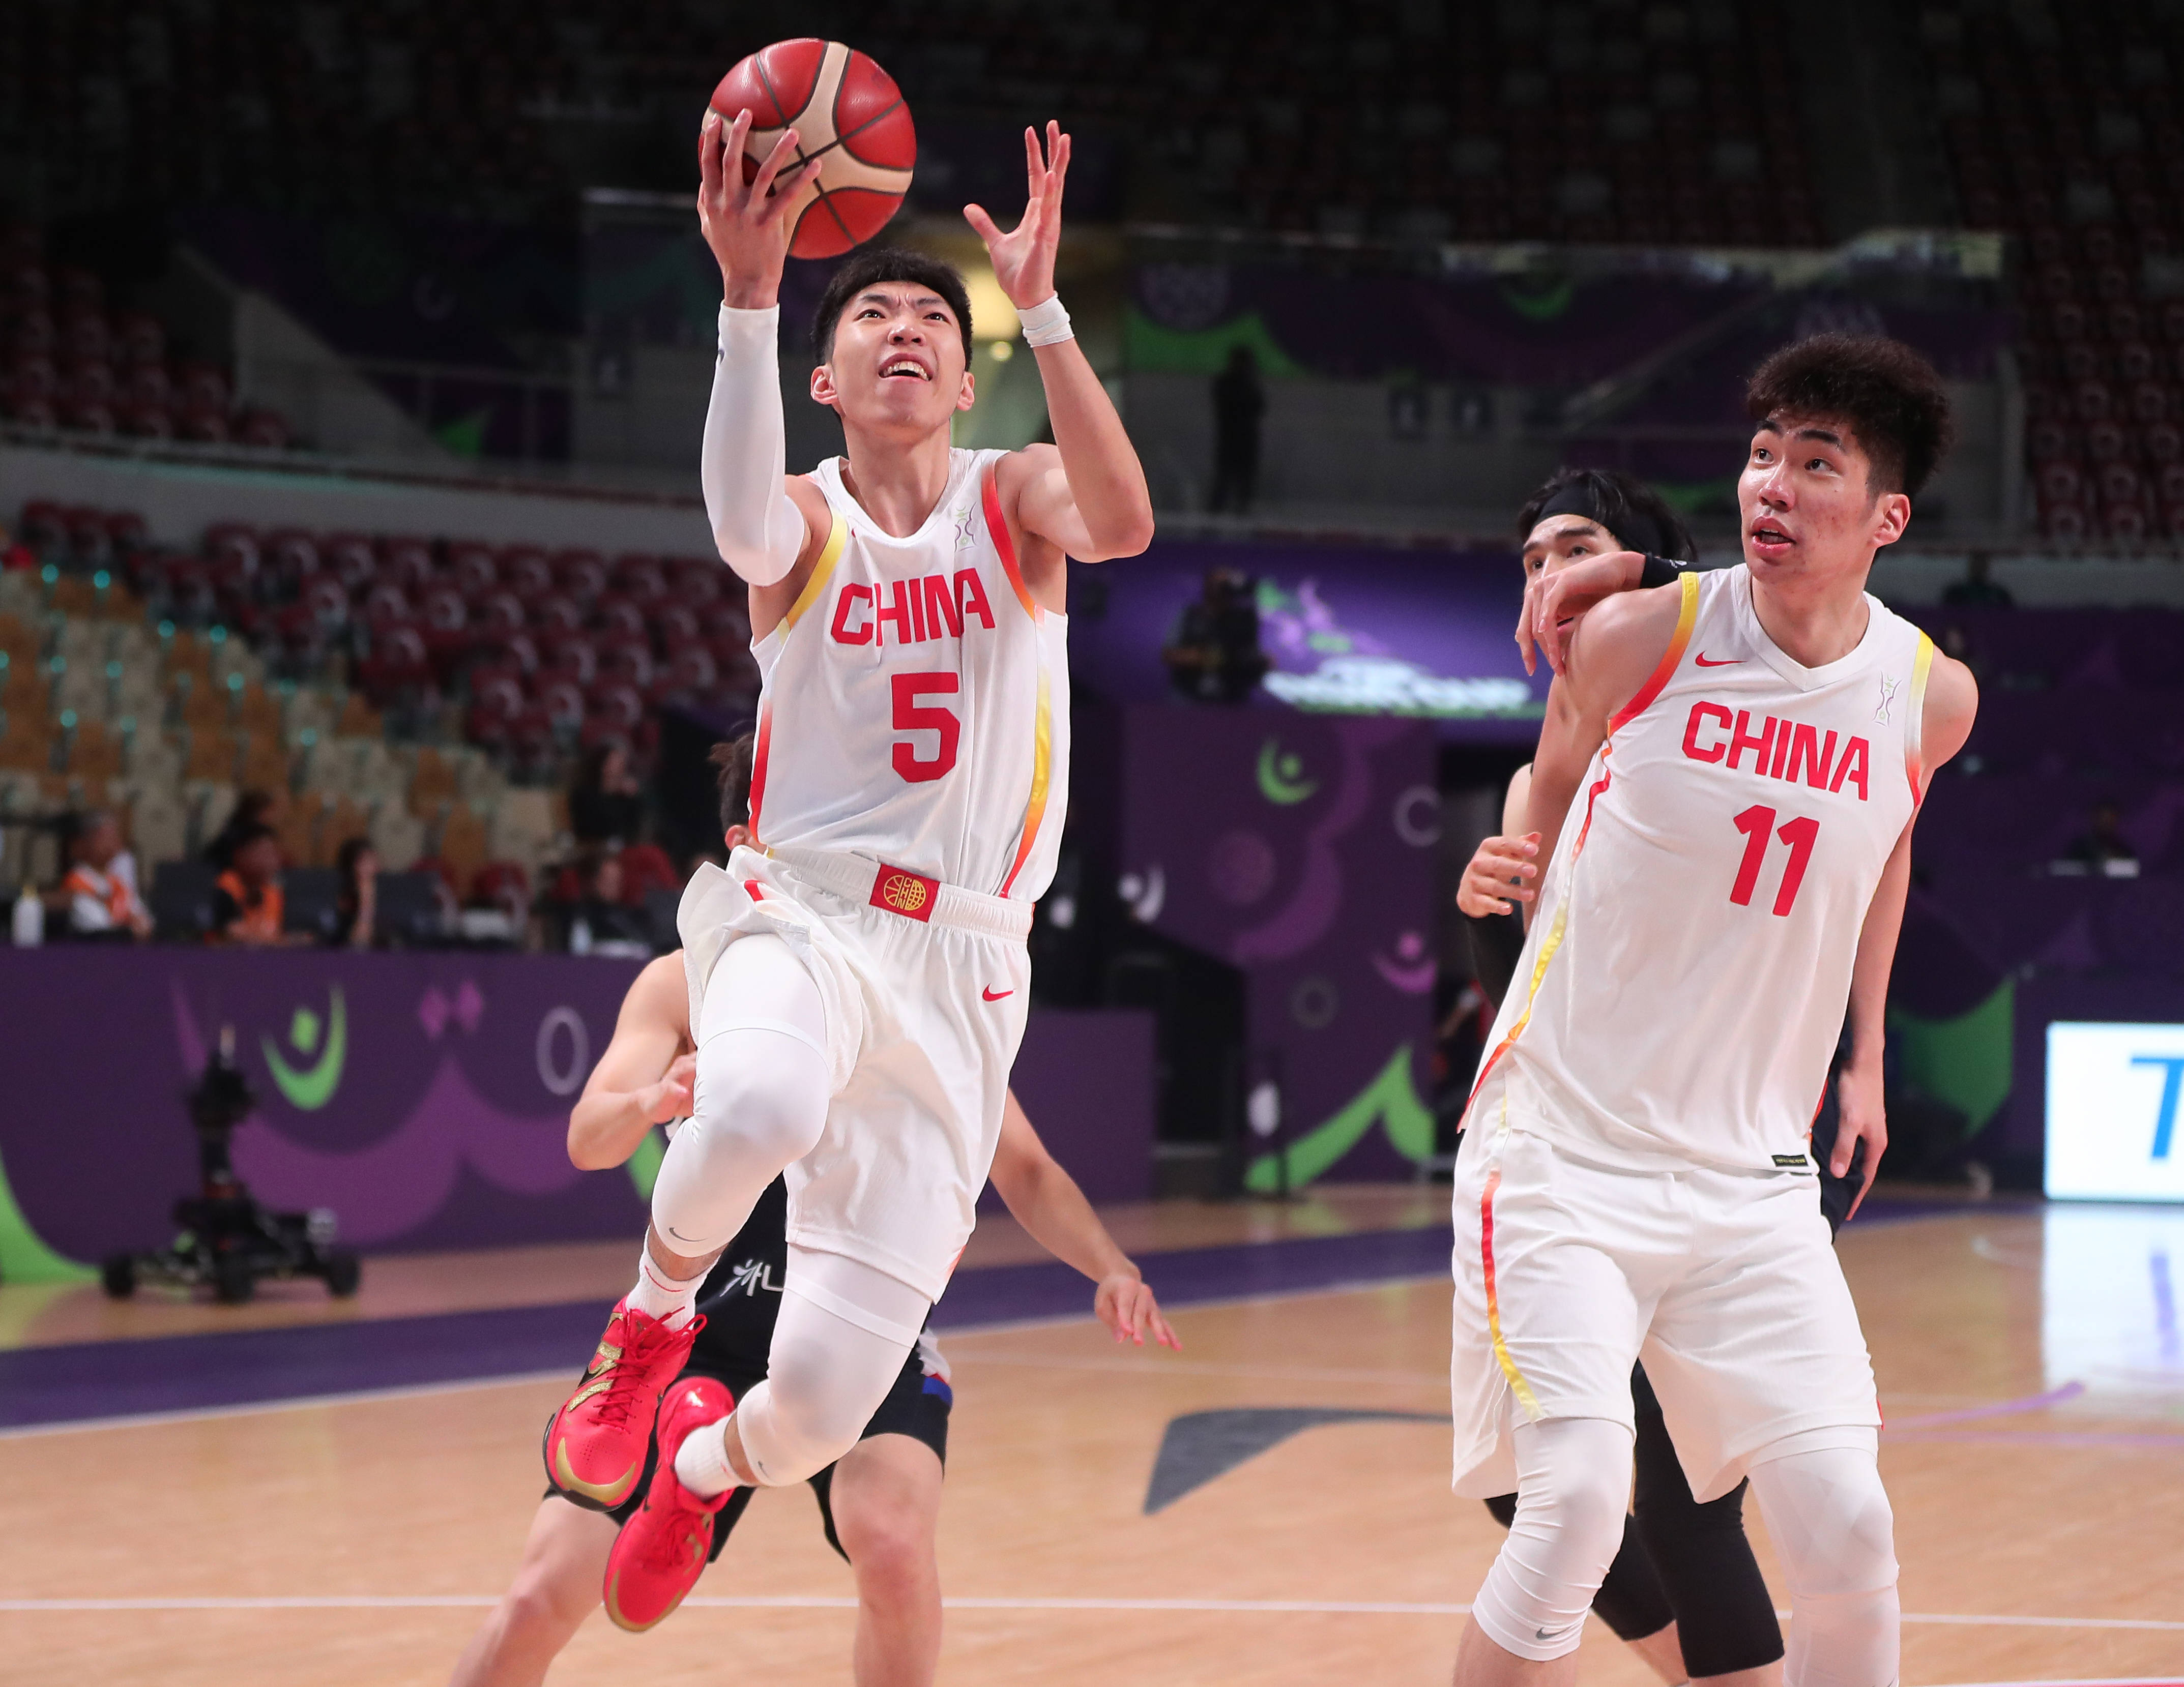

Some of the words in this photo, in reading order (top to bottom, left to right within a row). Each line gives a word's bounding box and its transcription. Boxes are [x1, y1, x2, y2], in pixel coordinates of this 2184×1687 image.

[831, 568, 996, 646] CHINA
[891, 672, 960, 783] 5
[1682, 701, 1869, 801] CHINA
[1730, 805, 1820, 917] 11
